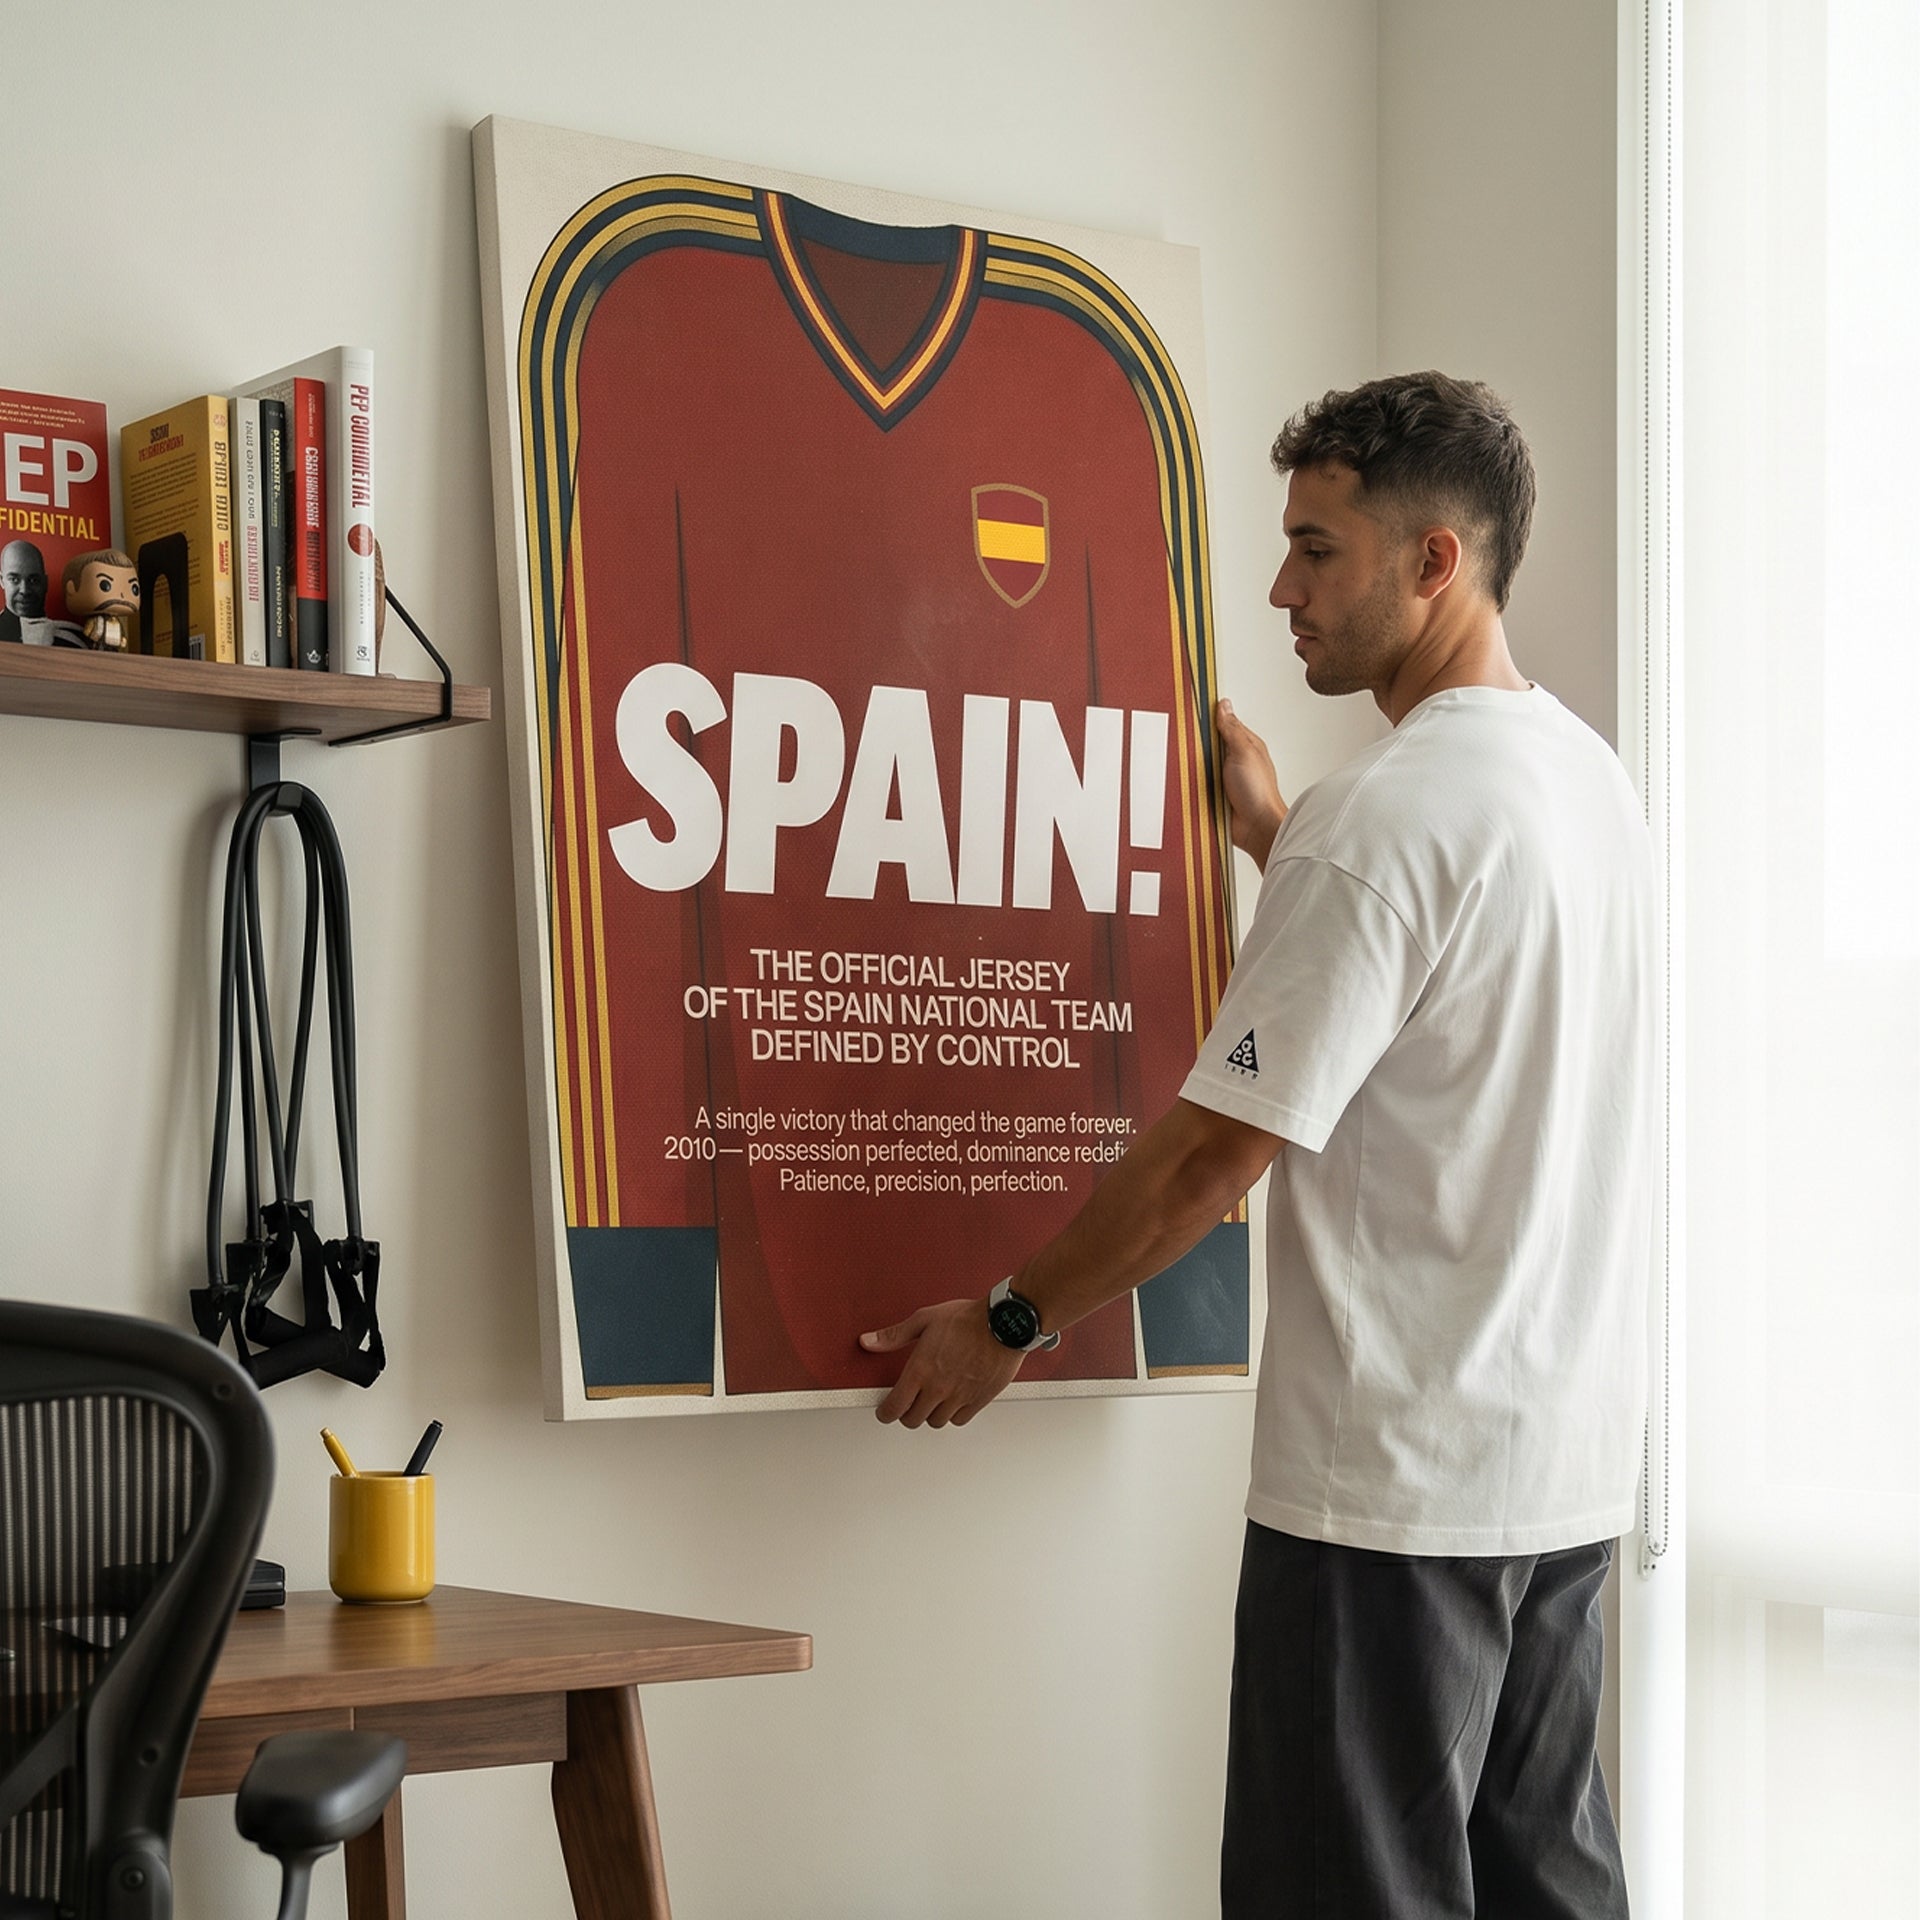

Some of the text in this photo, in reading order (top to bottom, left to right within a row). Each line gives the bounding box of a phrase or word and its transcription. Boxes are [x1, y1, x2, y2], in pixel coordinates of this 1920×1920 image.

[4, 432, 98, 509] EP
[608, 662, 1169, 916] SPAIN!
[750, 949, 1070, 991] THE OFFICIAL JERSEY
[684, 986, 1132, 1032] OF THE SPAIN NATIONAL TEAM
[752, 1029, 1080, 1068] DEFINED BY CONTROL
[695, 1107, 1136, 1138] A single victory that changed the game forever.
[749, 1139, 859, 1166] possession
[867, 1139, 962, 1166] perfected,
[968, 1140, 1070, 1162] dominance
[1075, 1141, 1128, 1162] redefi
[781, 1169, 1067, 1196] Patience, precision, perfection.
